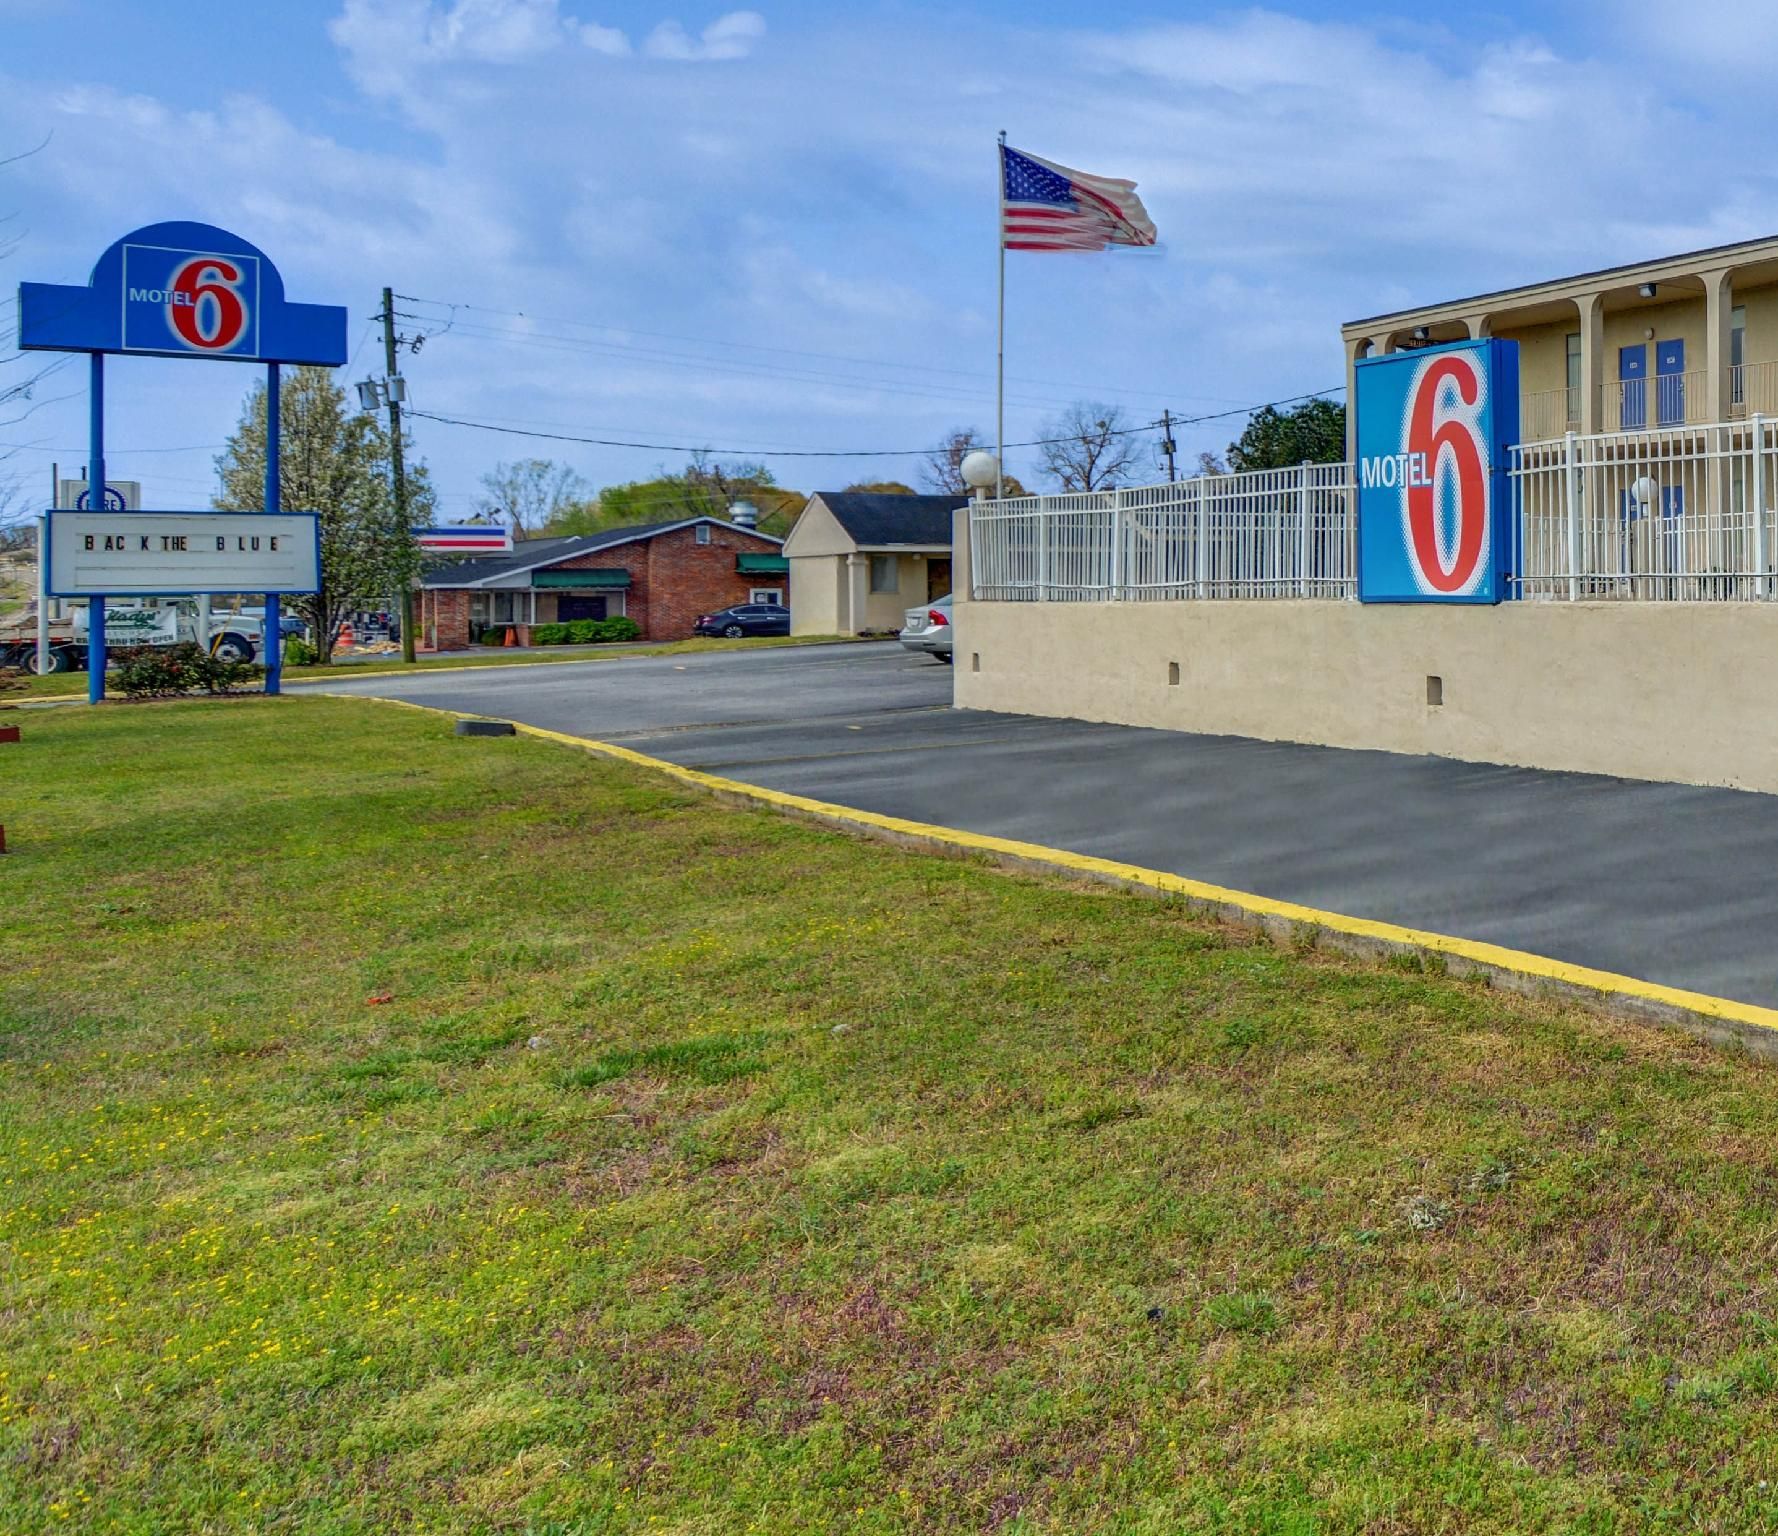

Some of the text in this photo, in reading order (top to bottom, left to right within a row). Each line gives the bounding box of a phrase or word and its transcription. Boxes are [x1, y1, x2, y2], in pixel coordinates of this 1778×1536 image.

[129, 257, 245, 350] MOTEL 6
[1361, 355, 1486, 593] MOTEL 6
[84, 535, 278, 551] BACK THE BLUE
